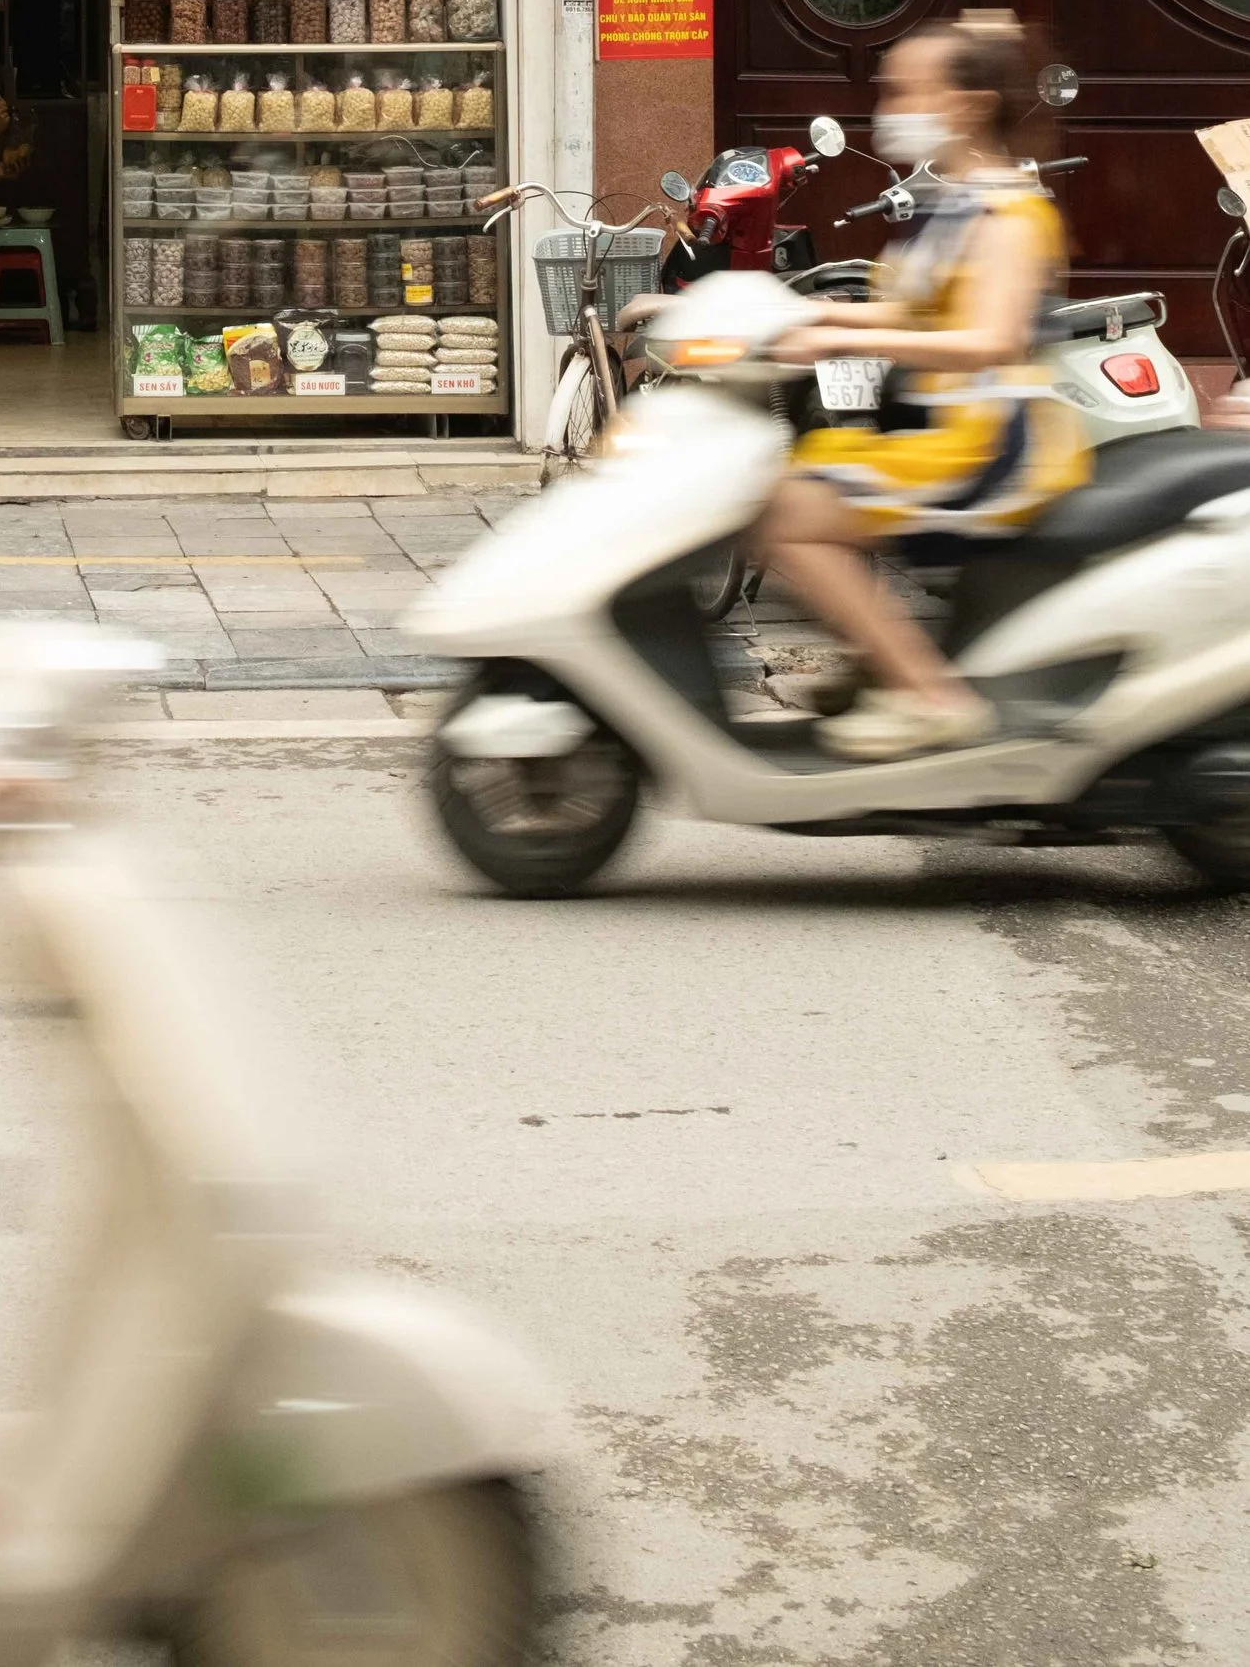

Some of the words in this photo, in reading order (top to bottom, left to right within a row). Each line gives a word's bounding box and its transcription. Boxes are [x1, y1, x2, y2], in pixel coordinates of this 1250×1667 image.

[828, 360, 885, 383] 29-C1
[139, 382, 158, 391] SEN
[437, 379, 455, 388] SEN
[826, 384, 883, 408] 567.6
